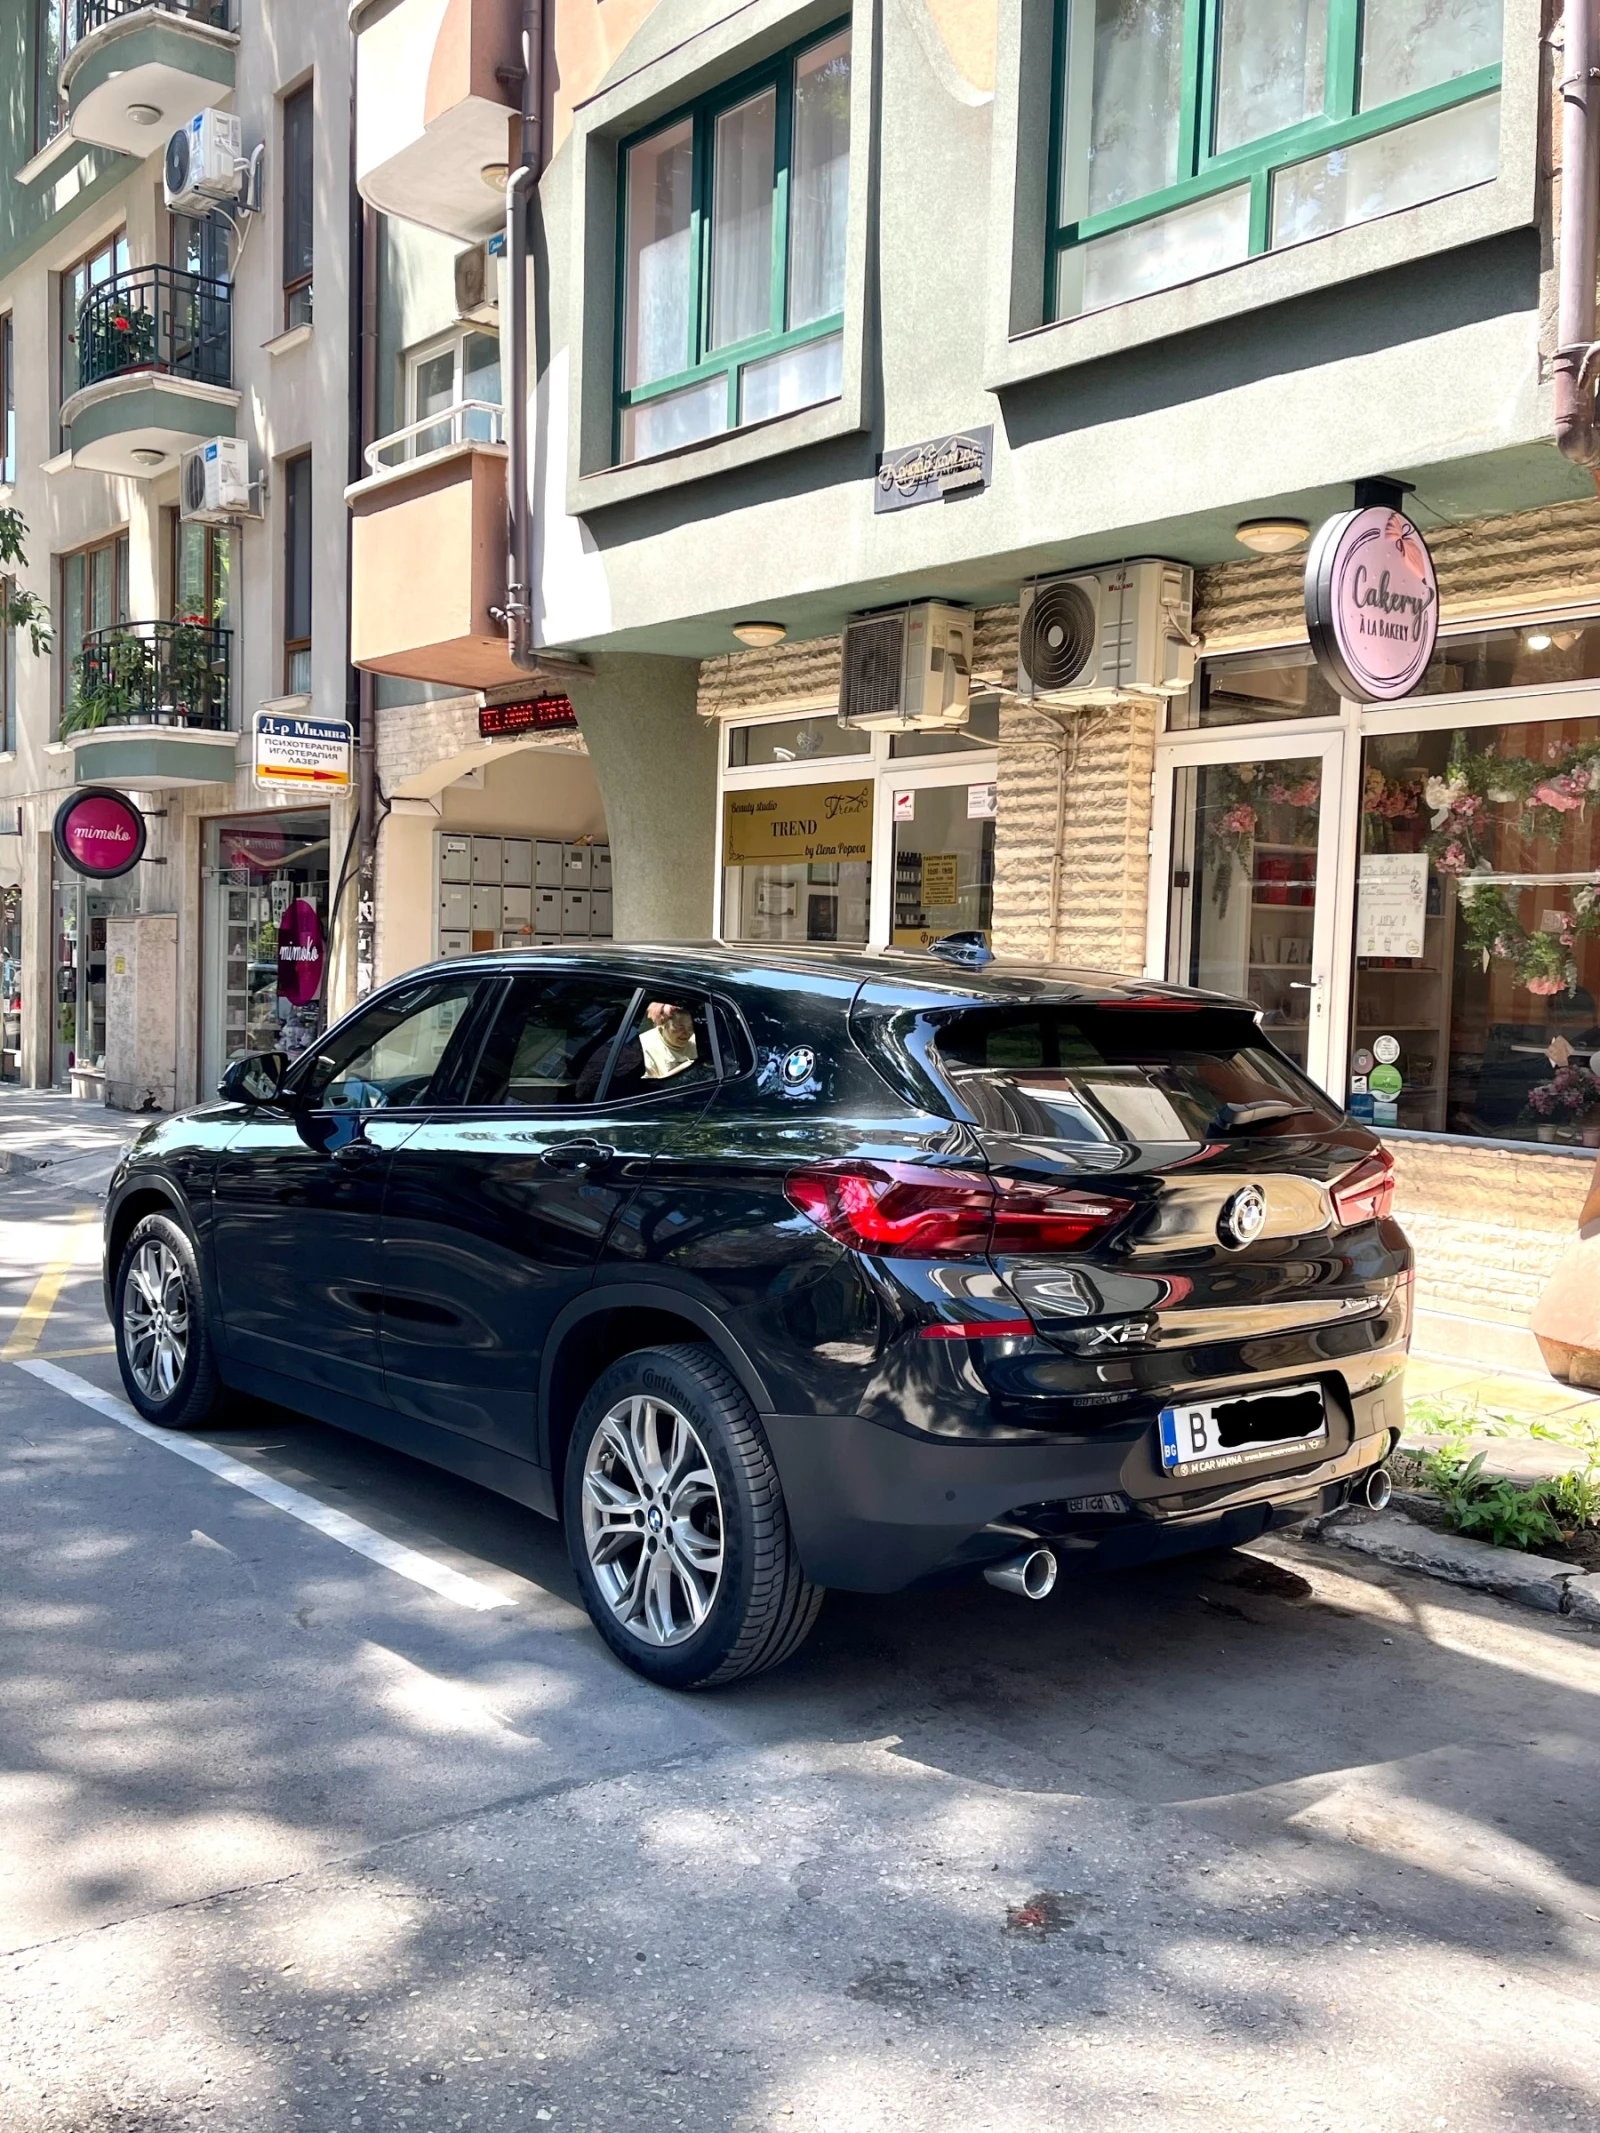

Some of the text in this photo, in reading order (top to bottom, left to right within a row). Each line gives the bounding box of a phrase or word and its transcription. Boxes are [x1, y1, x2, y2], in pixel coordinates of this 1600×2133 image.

[1352, 564, 1434, 642] Cakery
[1359, 613, 1410, 642] À LA BAKERY
[262, 718, 346, 739] Д-р Милина
[264, 738, 343, 752] ПСИХОТЕРАПИЯ
[269, 747, 338, 760] ИГЛОТЕРАПИЯ
[288, 757, 320, 765] ЛАЗЕР
[730, 800, 778, 815] Beauty studio
[74, 824, 131, 841] mimoko
[771, 819, 817, 837] TREND
[805, 842, 866, 859] by Elena Popova
[279, 936, 319, 961] mimoko
[1088, 1323, 1149, 1346] X2
[642, 1367, 709, 1428] Continental
[1189, 1412, 1208, 1453] B
[1164, 1445, 1177, 1457] BG
[1191, 1463, 1200, 1473] M
[1199, 1460, 1215, 1472] CAR
[1216, 1455, 1244, 1468] VARNA
